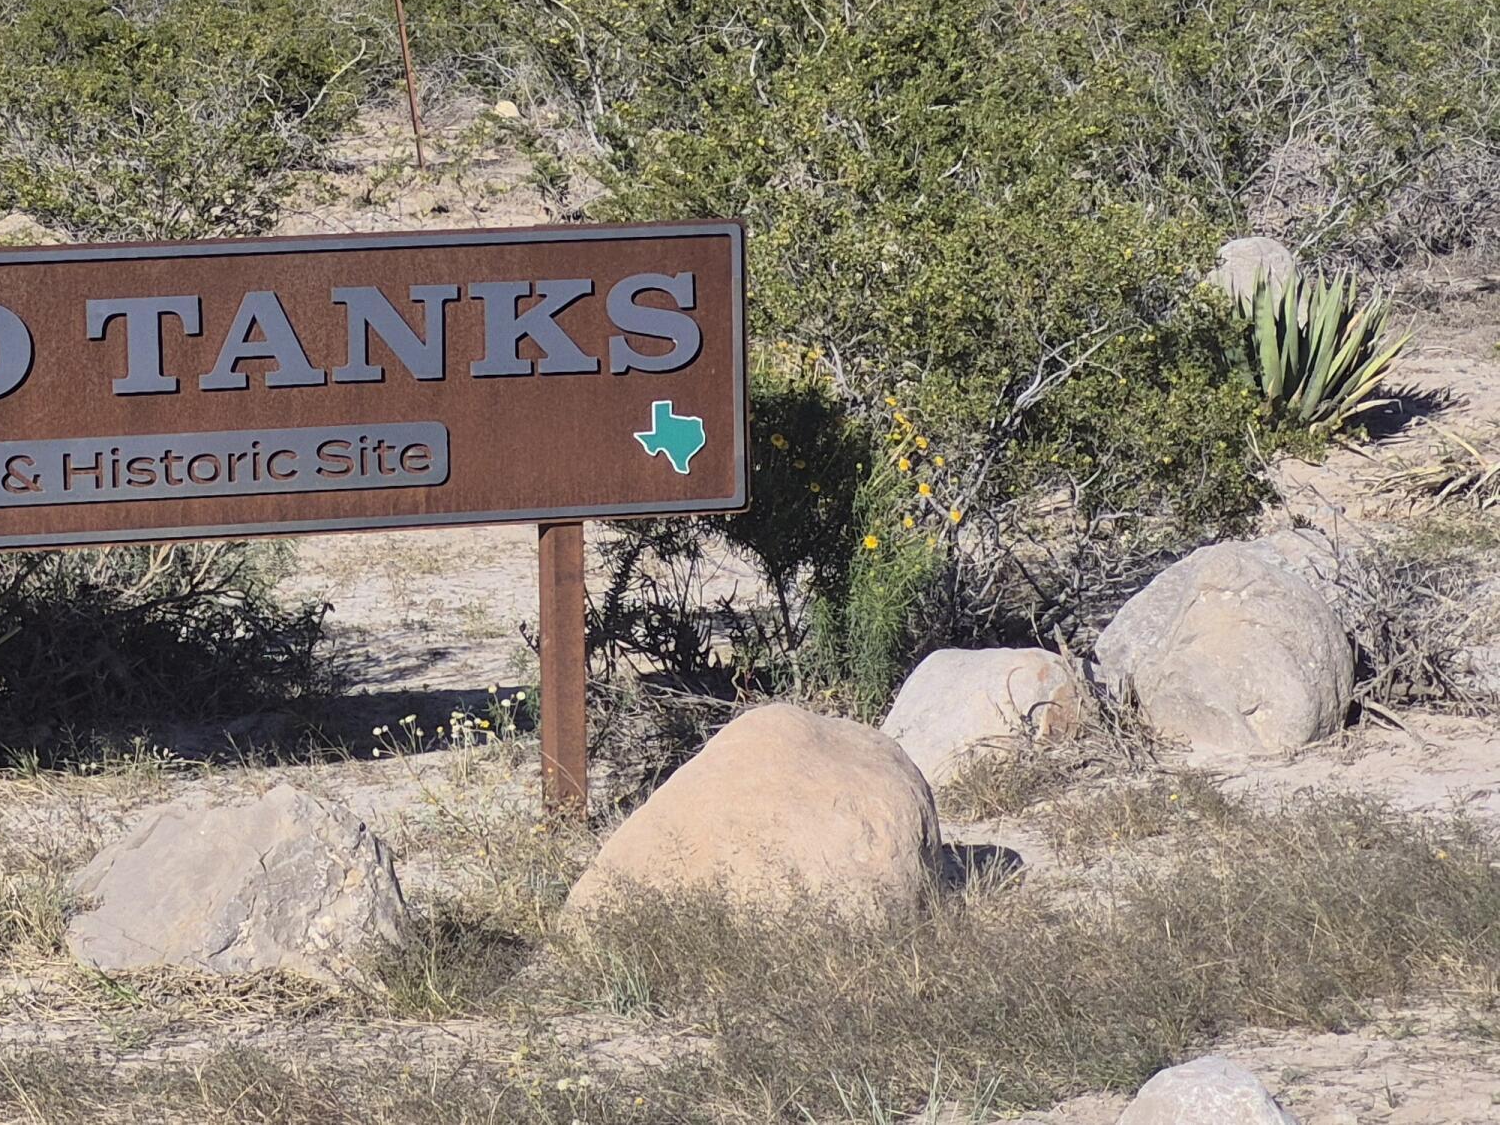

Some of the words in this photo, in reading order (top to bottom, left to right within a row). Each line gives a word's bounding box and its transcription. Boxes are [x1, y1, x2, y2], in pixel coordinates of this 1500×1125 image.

[86, 272, 703, 394] TANKS
[0, 453, 41, 494] &
[62, 440, 300, 491] Historic
[314, 435, 434, 479] Site
